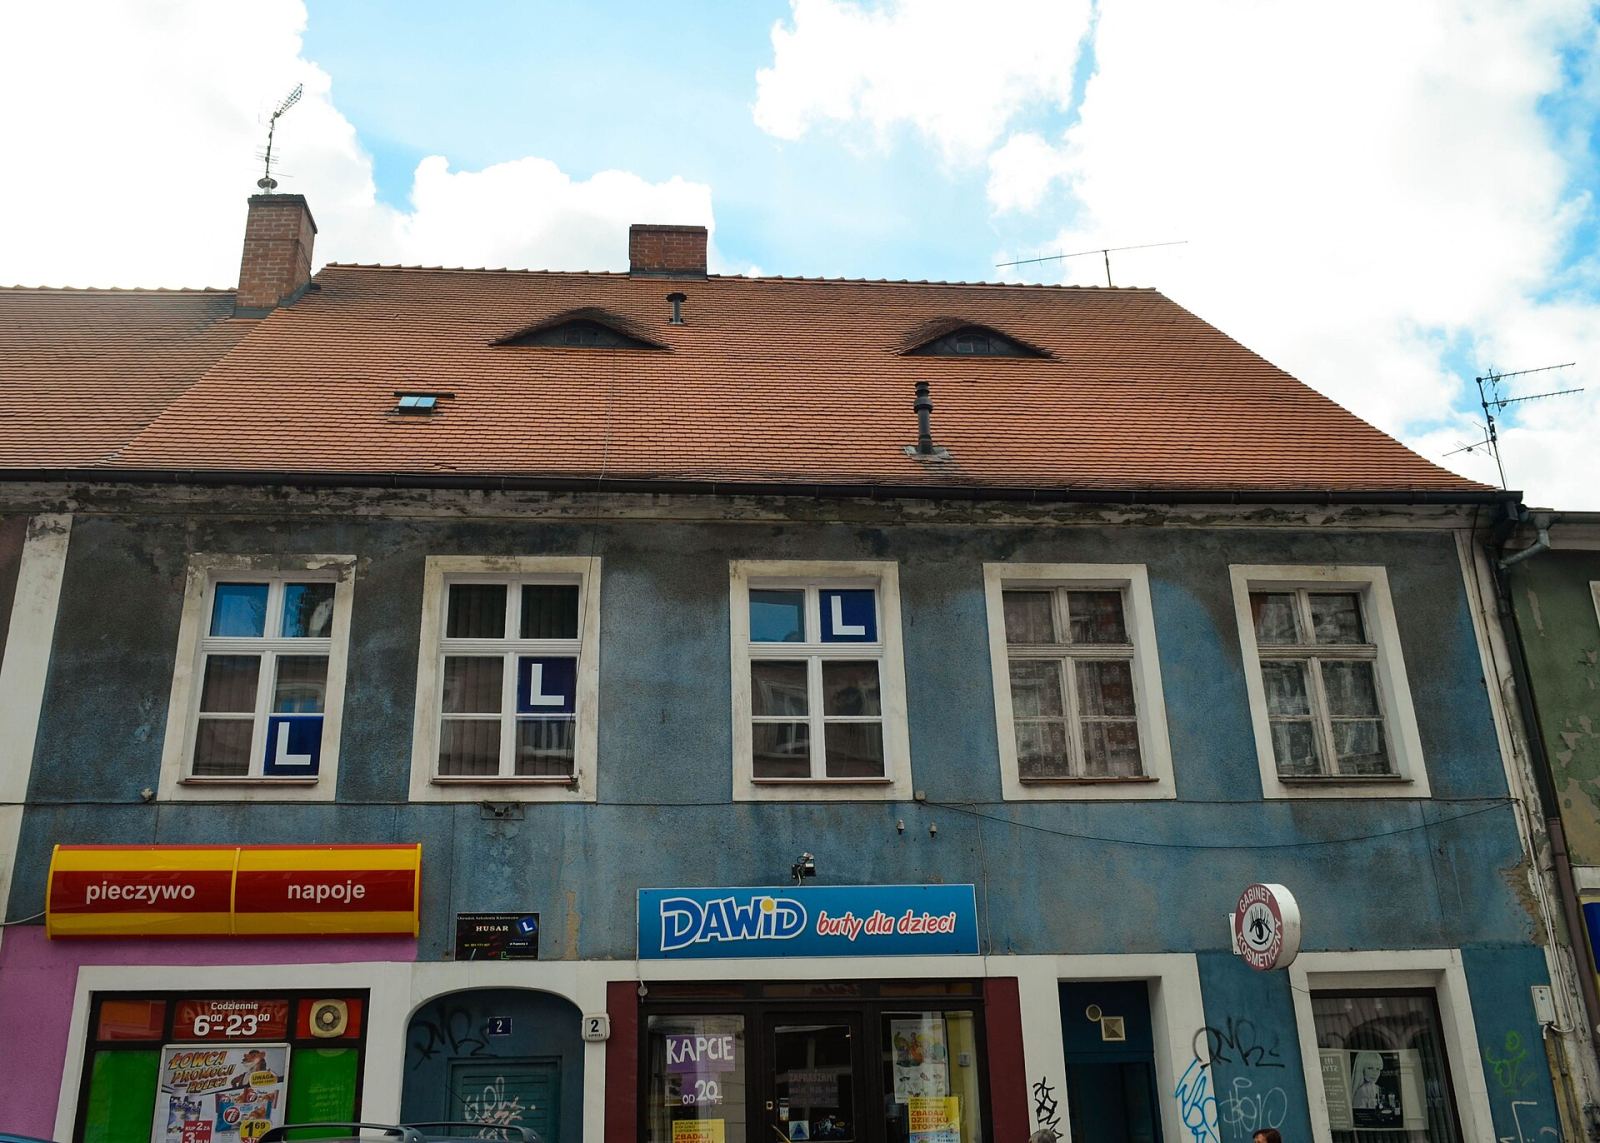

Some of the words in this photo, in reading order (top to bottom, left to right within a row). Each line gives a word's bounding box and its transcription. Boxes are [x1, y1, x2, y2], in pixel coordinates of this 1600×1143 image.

[830, 595, 866, 636] L
[530, 663, 565, 706] L
[274, 721, 311, 765] L
[86, 880, 196, 904] pieczywo
[287, 880, 366, 903] napoje
[1239, 886, 1271, 913] GABINET
[817, 910, 863, 941] buty
[864, 909, 893, 935] dla
[897, 909, 956, 935] dzieci
[211, 1001, 258, 1010] Codziennie
[496, 1020, 503, 1032] 2
[590, 1019, 599, 1032] 2
[666, 1036, 734, 1064] KAPCIE
